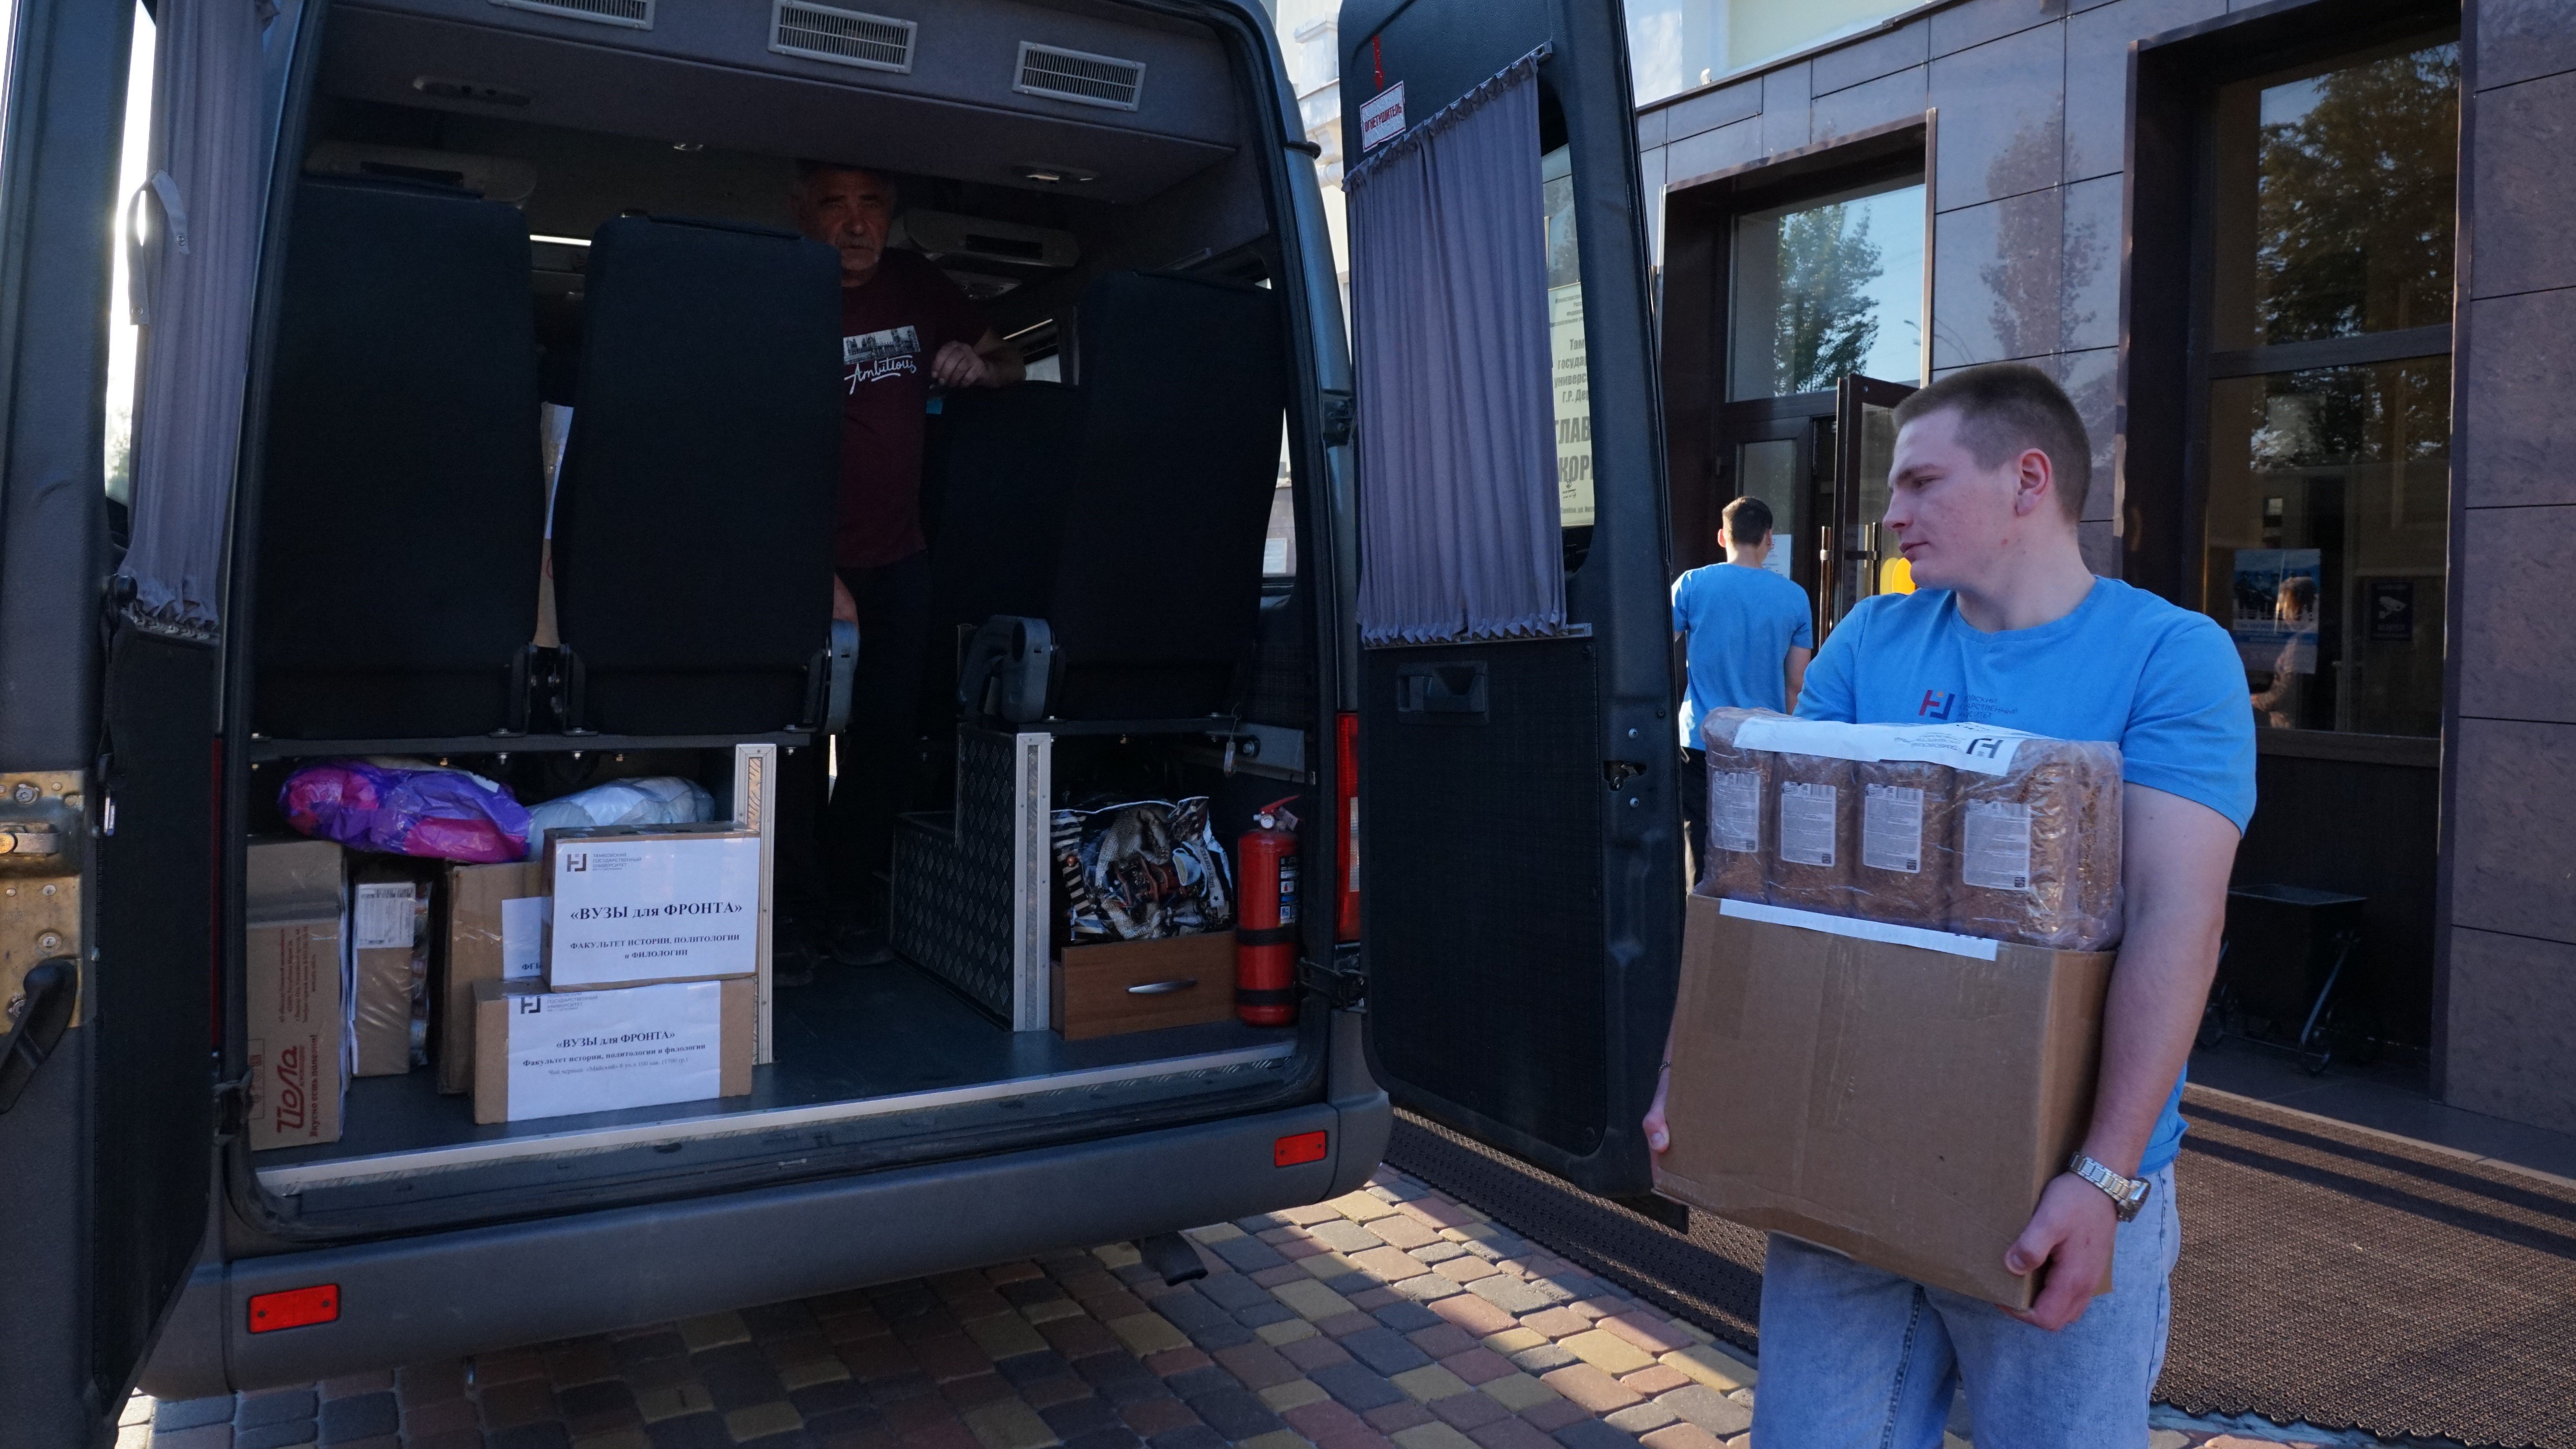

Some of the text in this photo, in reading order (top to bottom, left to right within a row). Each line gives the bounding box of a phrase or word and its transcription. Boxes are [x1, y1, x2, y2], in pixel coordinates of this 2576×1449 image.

[1364, 103, 1402, 133] ОГНЕТУШИТЕЛЬ
[571, 901, 742, 919] «ВУЗЫ для ФРОНТА»
[570, 934, 740, 949] ФАКУЛЬТЕТ ИСТОРИИ, ПОЛИТОЛОГИИ
[632, 950, 687, 958] ФИЛОЛОГИИ
[556, 1036, 597, 1048] «ВУЗЫ
[621, 1031, 675, 1043] ФРОНТА»
[523, 1058, 566, 1066] Факультет
[569, 1054, 604, 1063] истории,
[606, 1049, 656, 1059] политологии
[665, 1044, 705, 1054] филологии
